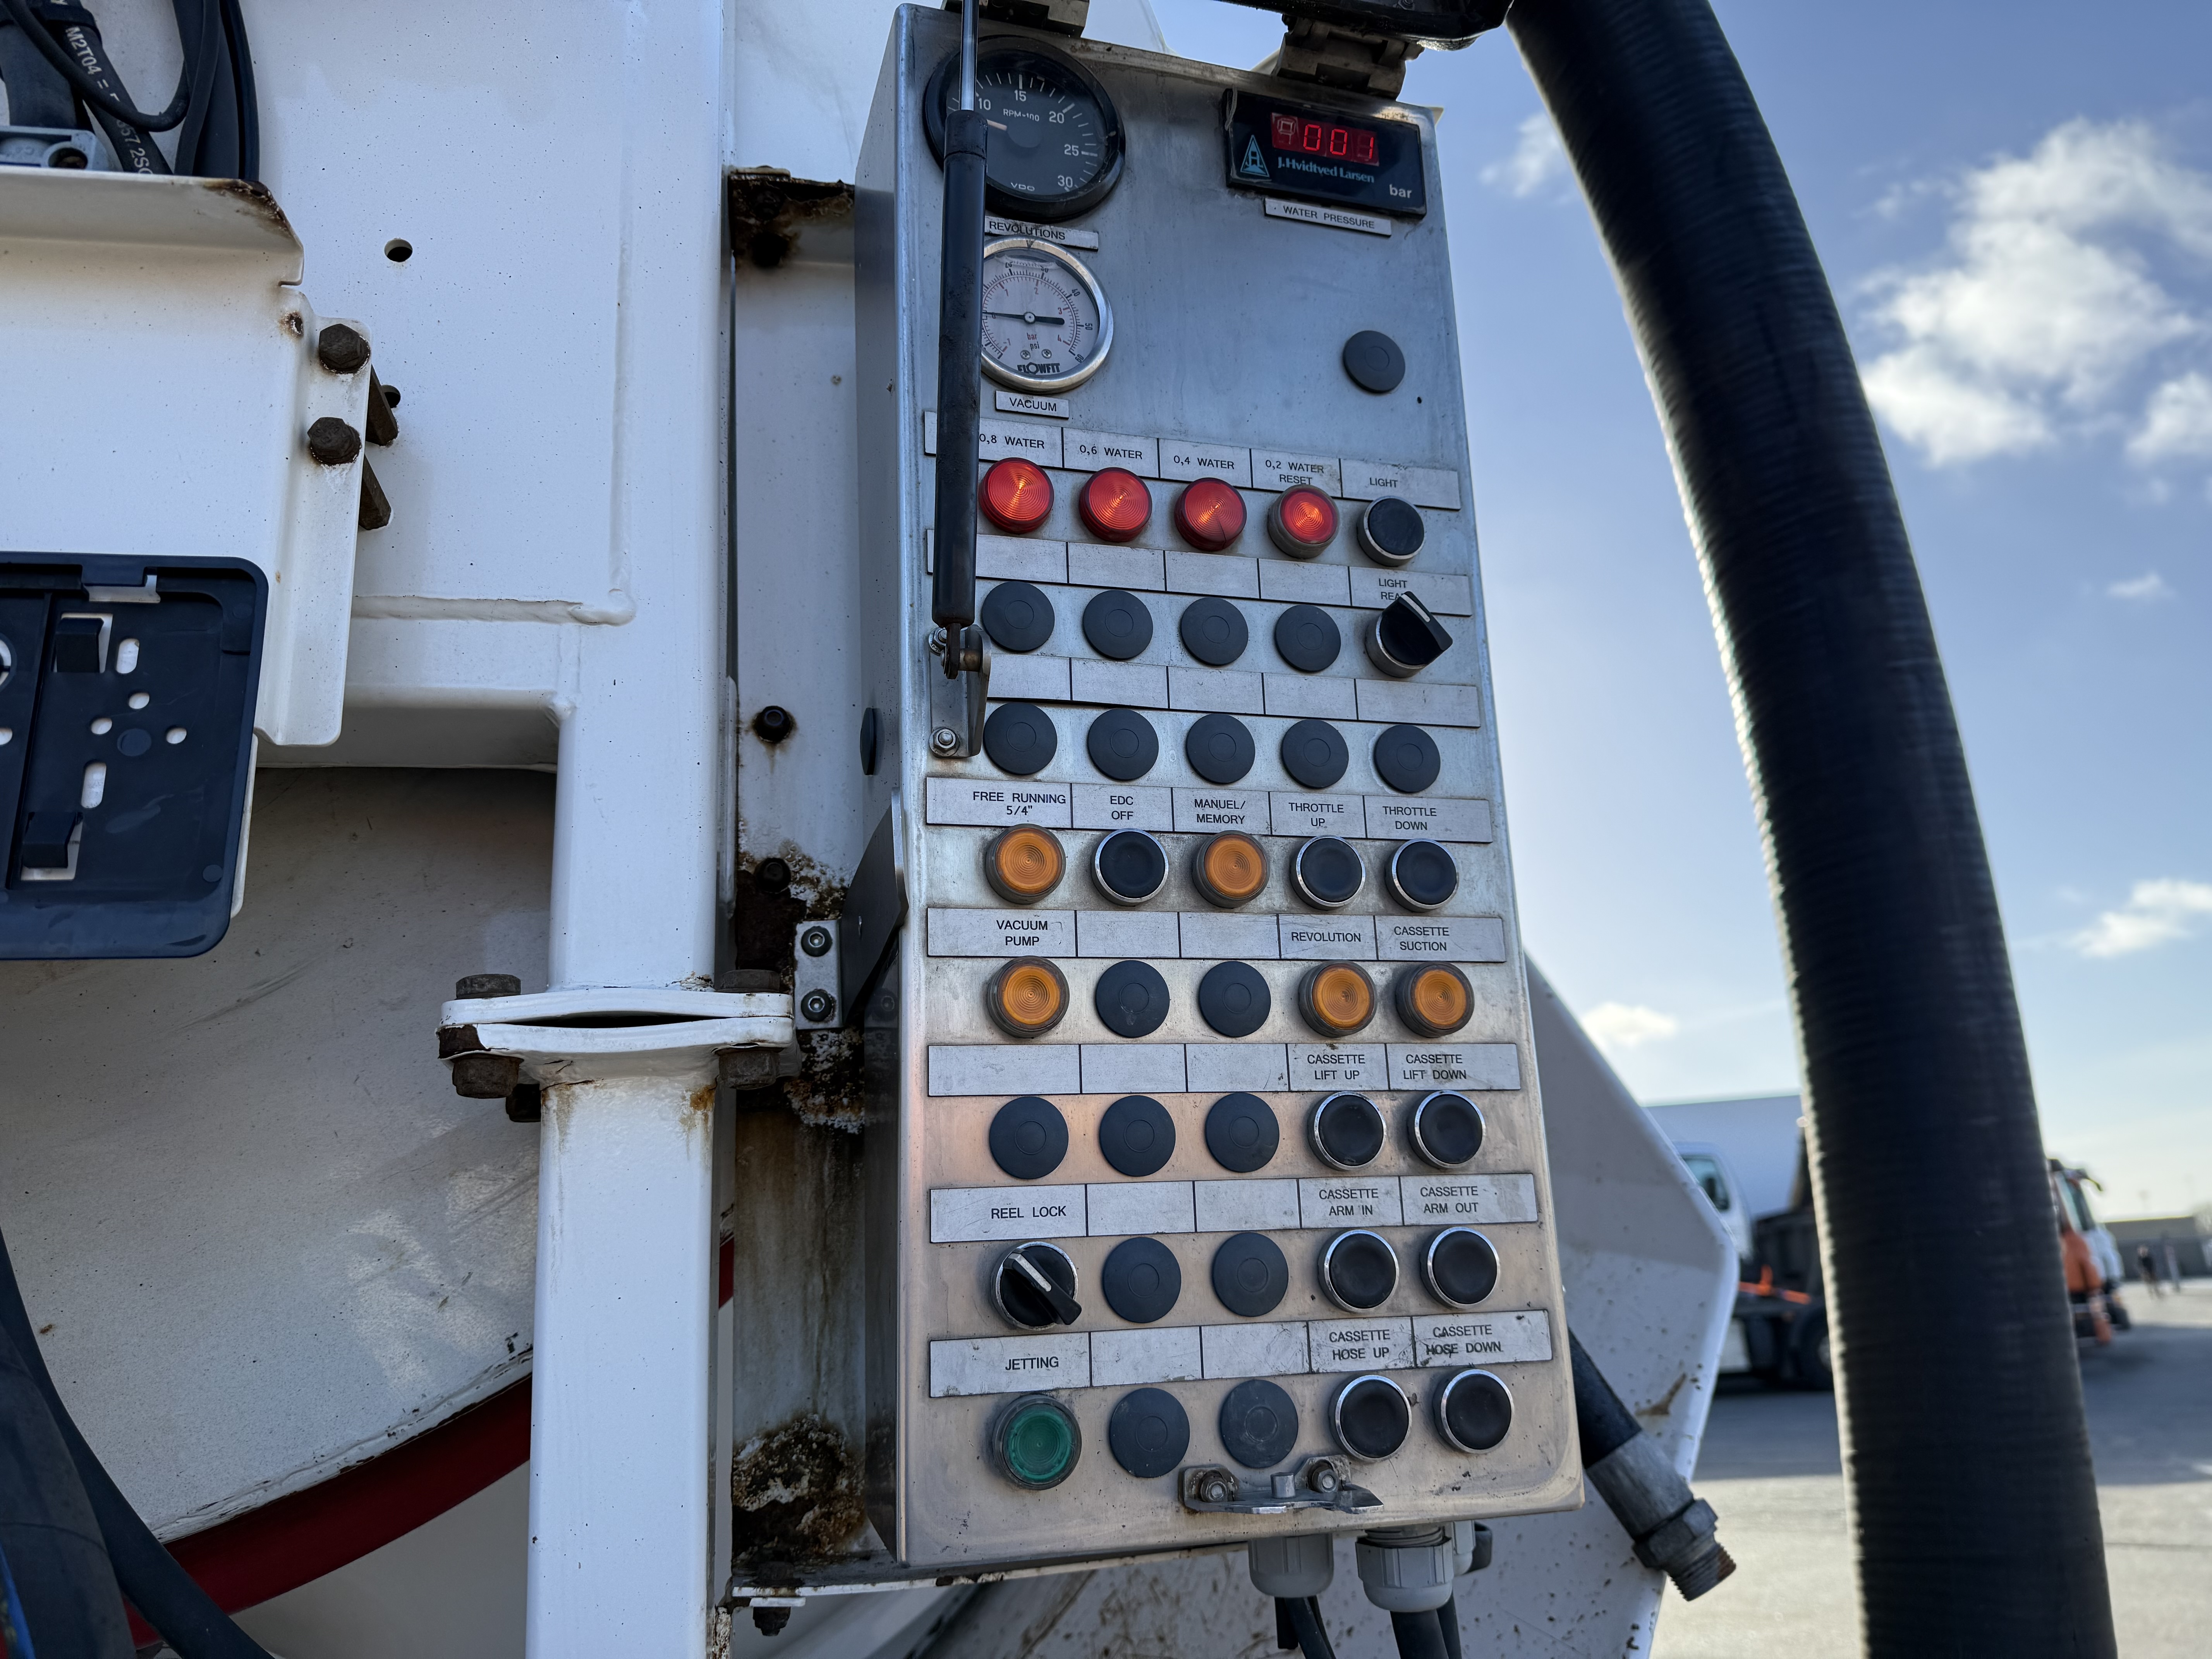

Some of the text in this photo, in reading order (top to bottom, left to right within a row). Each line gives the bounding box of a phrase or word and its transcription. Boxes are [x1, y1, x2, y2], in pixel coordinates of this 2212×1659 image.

[1015, 89, 1026, 101] 15
[978, 98, 991, 110] 10
[1049, 111, 1065, 124] 20
[1064, 144, 1079, 156] 25
[1339, 167, 1374, 183] Larsen
[1010, 182, 1035, 191] VDO
[1057, 175, 1073, 188] 30
[1389, 184, 1412, 198] bar
[1283, 205, 1375, 229] WATER PRESSURE
[989, 221, 1066, 240] REVOLUTIONS
[1072, 289, 1080, 297] 40
[1030, 341, 1040, 351] psi
[1017, 362, 1060, 374] FLOWFIT
[1009, 397, 1057, 412] VACUUM
[979, 433, 1044, 449] 0,8 WATER
[1080, 445, 1142, 460] 0,6 WATER
[1173, 455, 1235, 469] 0,4 WATER
[1265, 459, 1324, 474] 0,2 WATER
[1279, 474, 1312, 485] RESET
[1369, 477, 1398, 488] LIGHT
[1379, 578, 1407, 588] LIGHT
[1381, 591, 1403, 600] REA
[973, 791, 1066, 804] FREE RUNNING
[1110, 795, 1133, 805] EDC
[1194, 799, 1246, 810] MANUEL/
[1288, 802, 1344, 813] THROTTLE
[1006, 805, 1032, 816] 5/4"
[1111, 811, 1134, 820] OFF
[1382, 806, 1437, 816] THROTTLE
[1196, 814, 1245, 824] MEMORY
[1311, 817, 1325, 827] UP
[1395, 821, 1427, 831] DOWN
[996, 920, 1048, 930] VACUUM
[1394, 926, 1449, 936] CASSETTE
[1005, 936, 1039, 946] PUMP
[1291, 932, 1361, 942] REVOLUTION
[1400, 941, 1447, 951] SUCTION
[1307, 1054, 1365, 1064] CASSETTE
[1406, 1054, 1463, 1064] CASSETTE
[1314, 1070, 1360, 1080] LIFT UP
[1403, 1070, 1467, 1080] LIFT DOWN
[1319, 1188, 1379, 1200] CASSETTE
[1420, 1186, 1479, 1197] CASSETTE
[991, 1206, 1066, 1219] REEL LOCK
[1329, 1205, 1373, 1216] ARM IN
[1424, 1202, 1479, 1214] ARM OUT
[1329, 1329, 1391, 1343] CASSETTE
[1433, 1324, 1492, 1338] CASSETTE
[1332, 1347, 1390, 1360] HOSE UP
[1427, 1341, 1501, 1356] HOSE DOWN
[1005, 1356, 1059, 1370] JETTING
